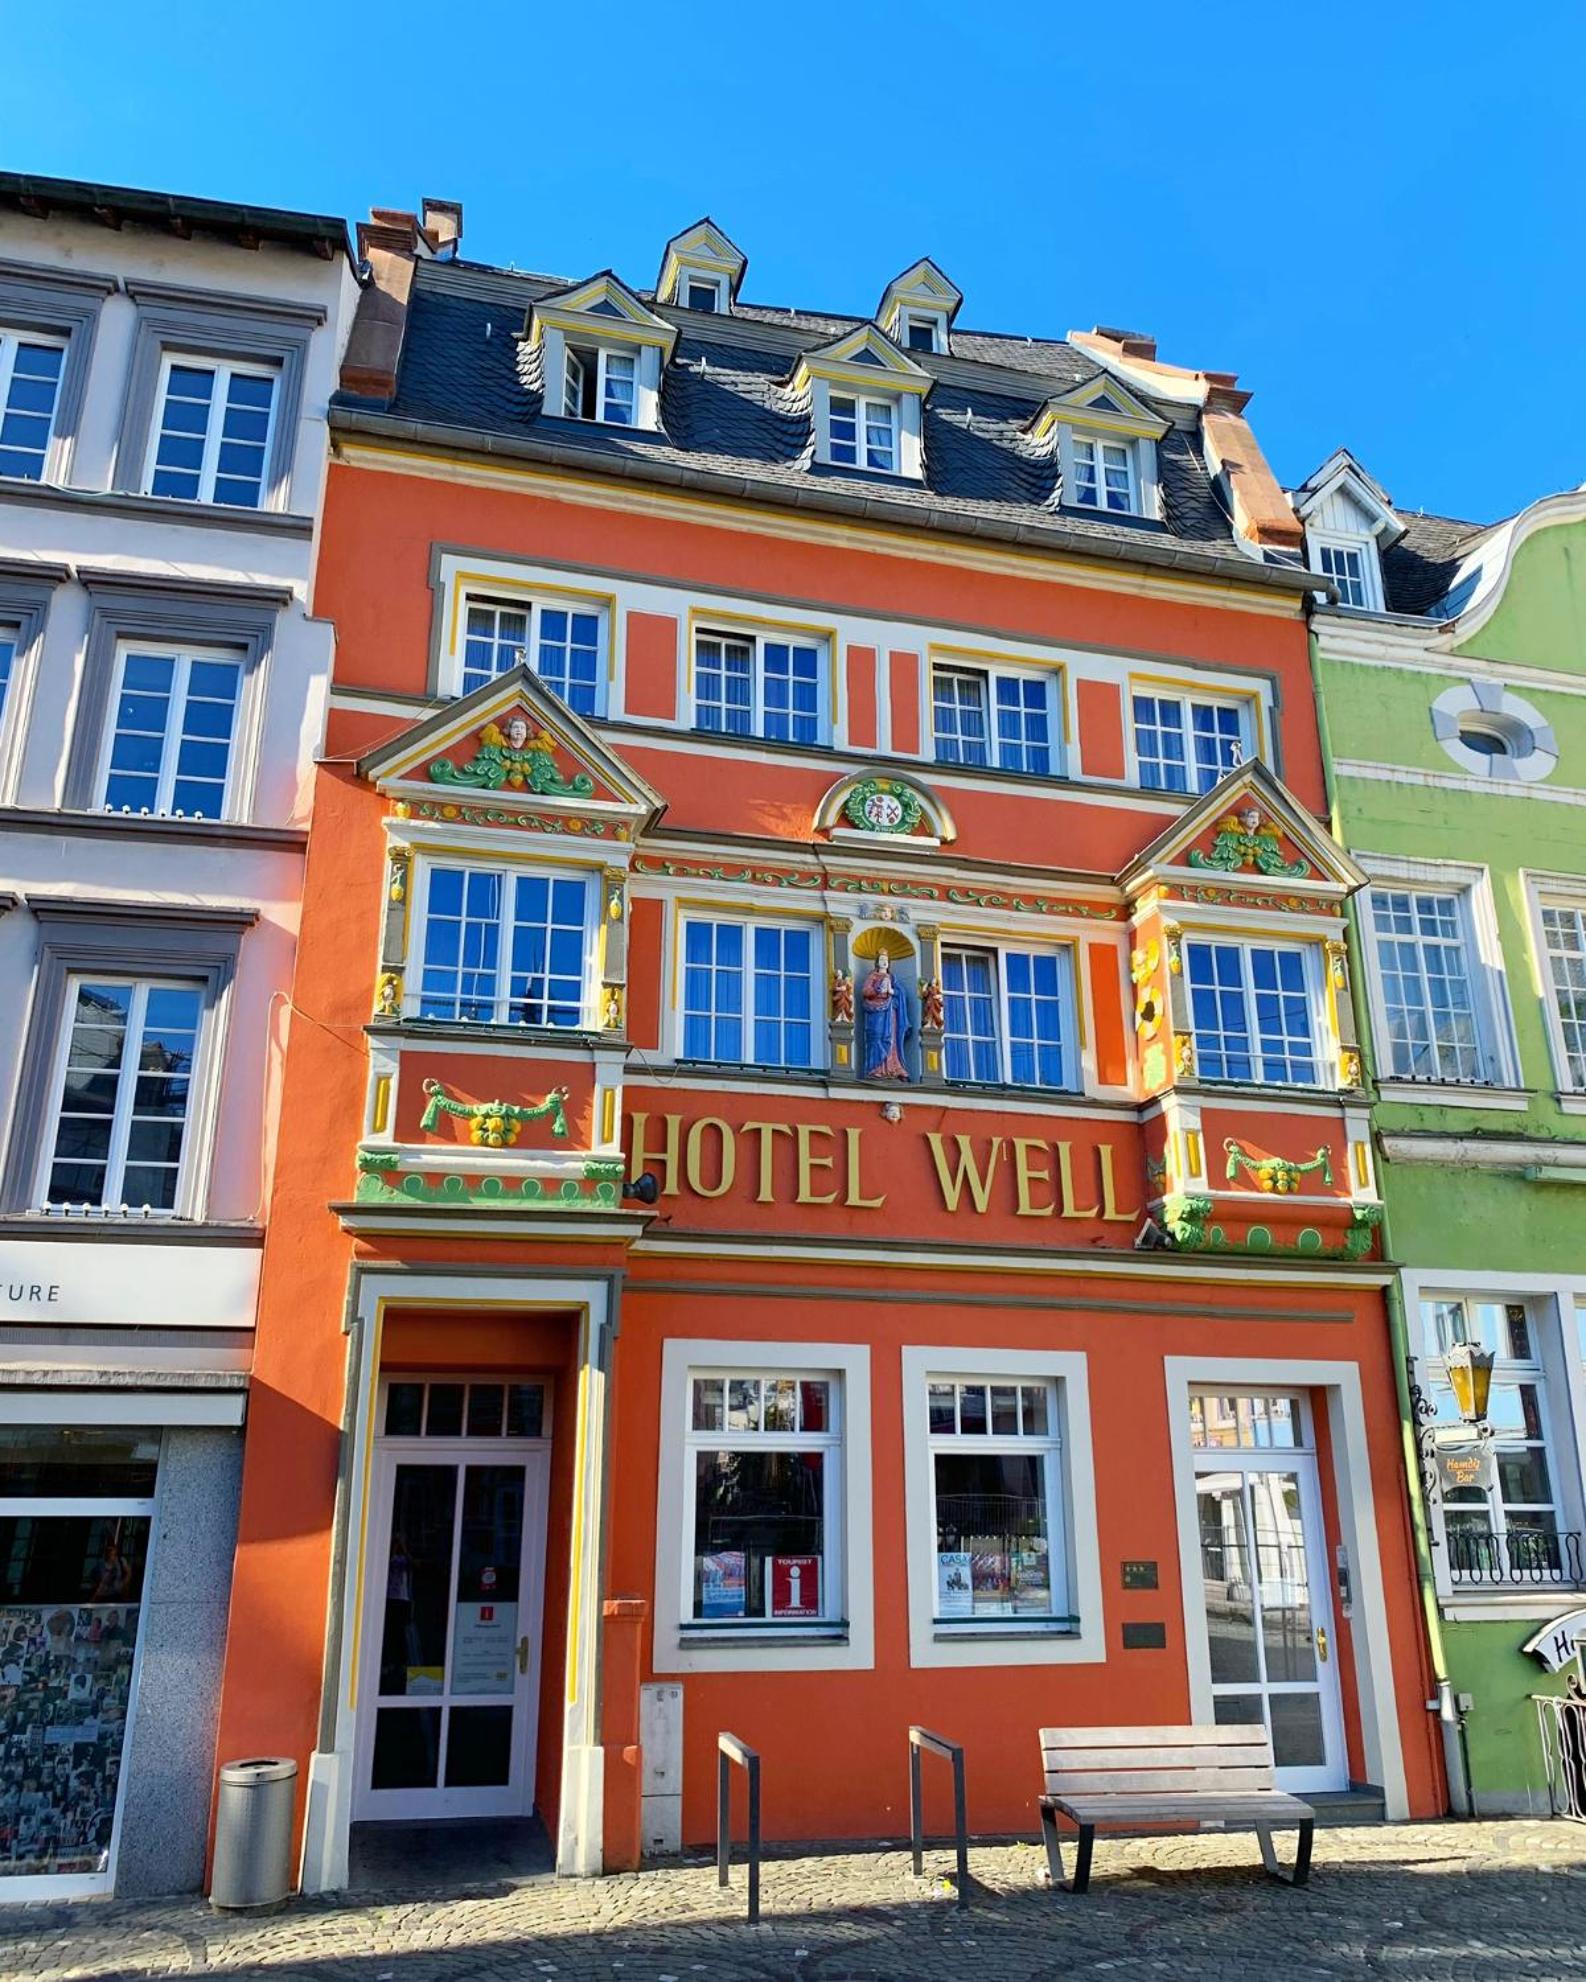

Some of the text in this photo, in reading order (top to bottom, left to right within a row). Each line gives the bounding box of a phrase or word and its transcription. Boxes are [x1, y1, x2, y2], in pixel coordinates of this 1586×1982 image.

[630, 1112, 1141, 1221] HOTEL WELL
[0, 1284, 60, 1301] URE
[1456, 1471, 1475, 1484] Bar
